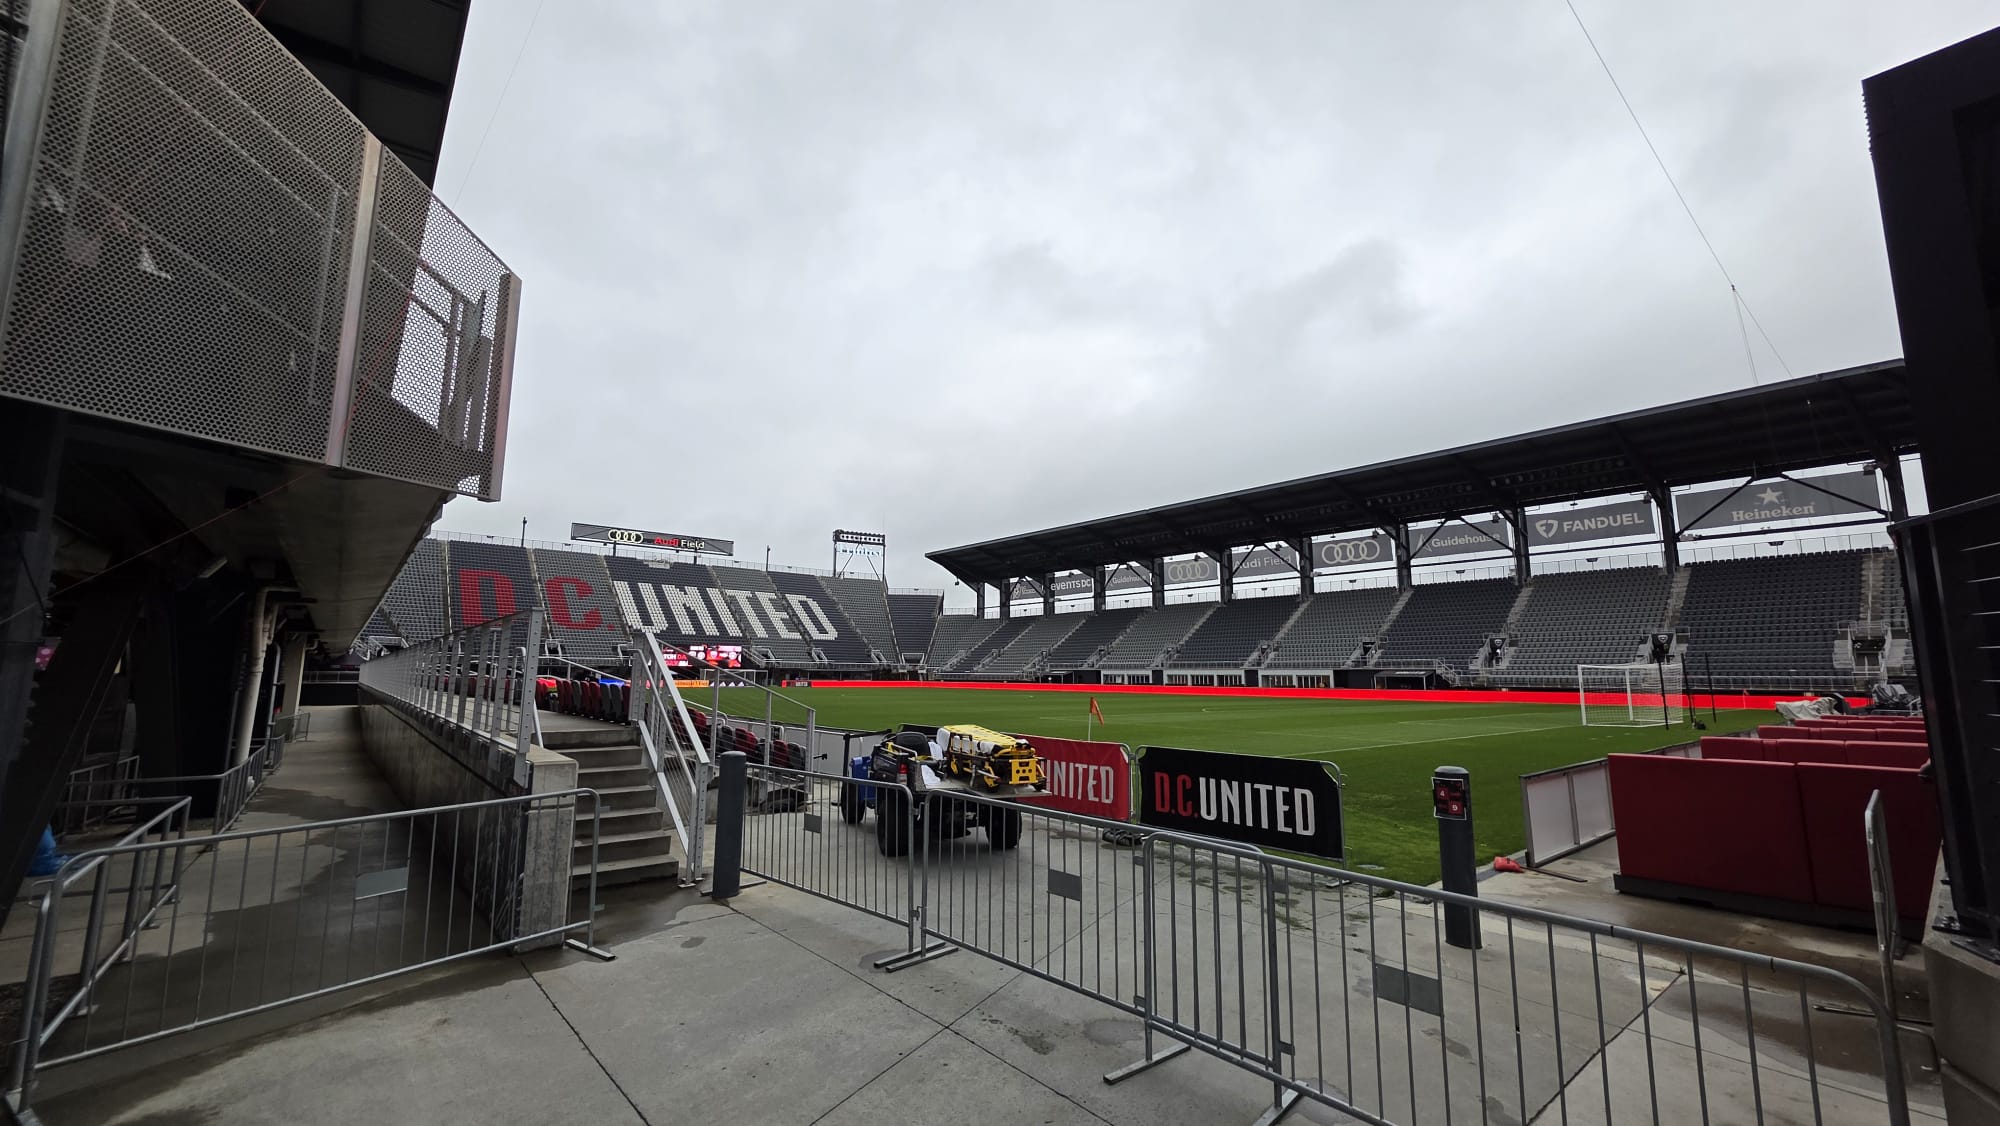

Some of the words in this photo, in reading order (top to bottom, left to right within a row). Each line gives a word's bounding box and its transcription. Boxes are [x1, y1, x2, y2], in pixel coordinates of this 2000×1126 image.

[1732, 504, 1814, 521] Heineken
[1563, 512, 1644, 532] FANDUEL
[654, 537, 679, 547] Audi
[680, 539, 705, 550] Field
[1432, 533, 1500, 547] Guidehouse
[1233, 558, 1261, 570] Audi
[1263, 555, 1291, 568] Fied
[1112, 574, 1146, 584] Guidehou
[613, 580, 838, 641] UNITED
